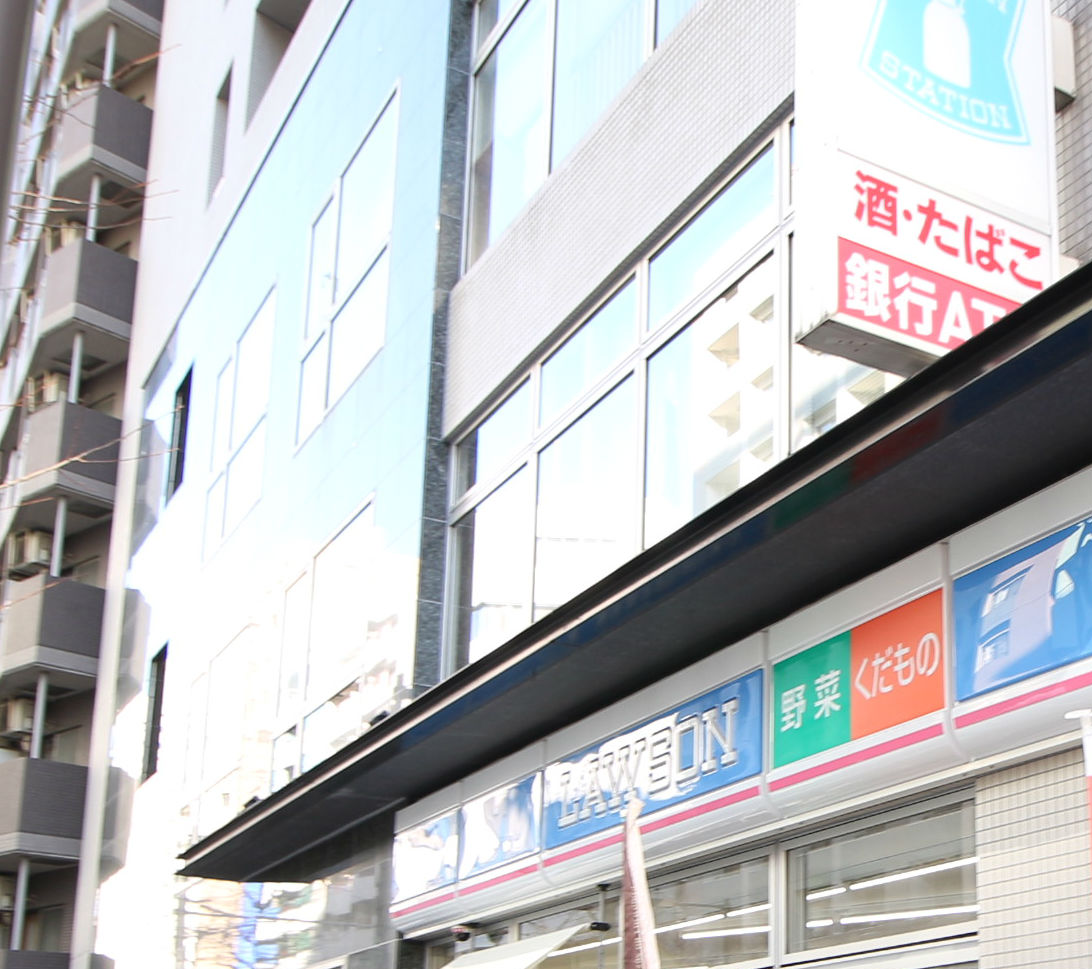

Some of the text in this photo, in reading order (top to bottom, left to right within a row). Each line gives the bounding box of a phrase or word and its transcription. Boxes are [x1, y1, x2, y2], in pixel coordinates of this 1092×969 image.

[879, 49, 1013, 130] STATION
[844, 252, 1008, 344] 銀行AT
[780, 632, 941, 733] 野菜 くだもの
[558, 696, 740, 830] LAWSON
